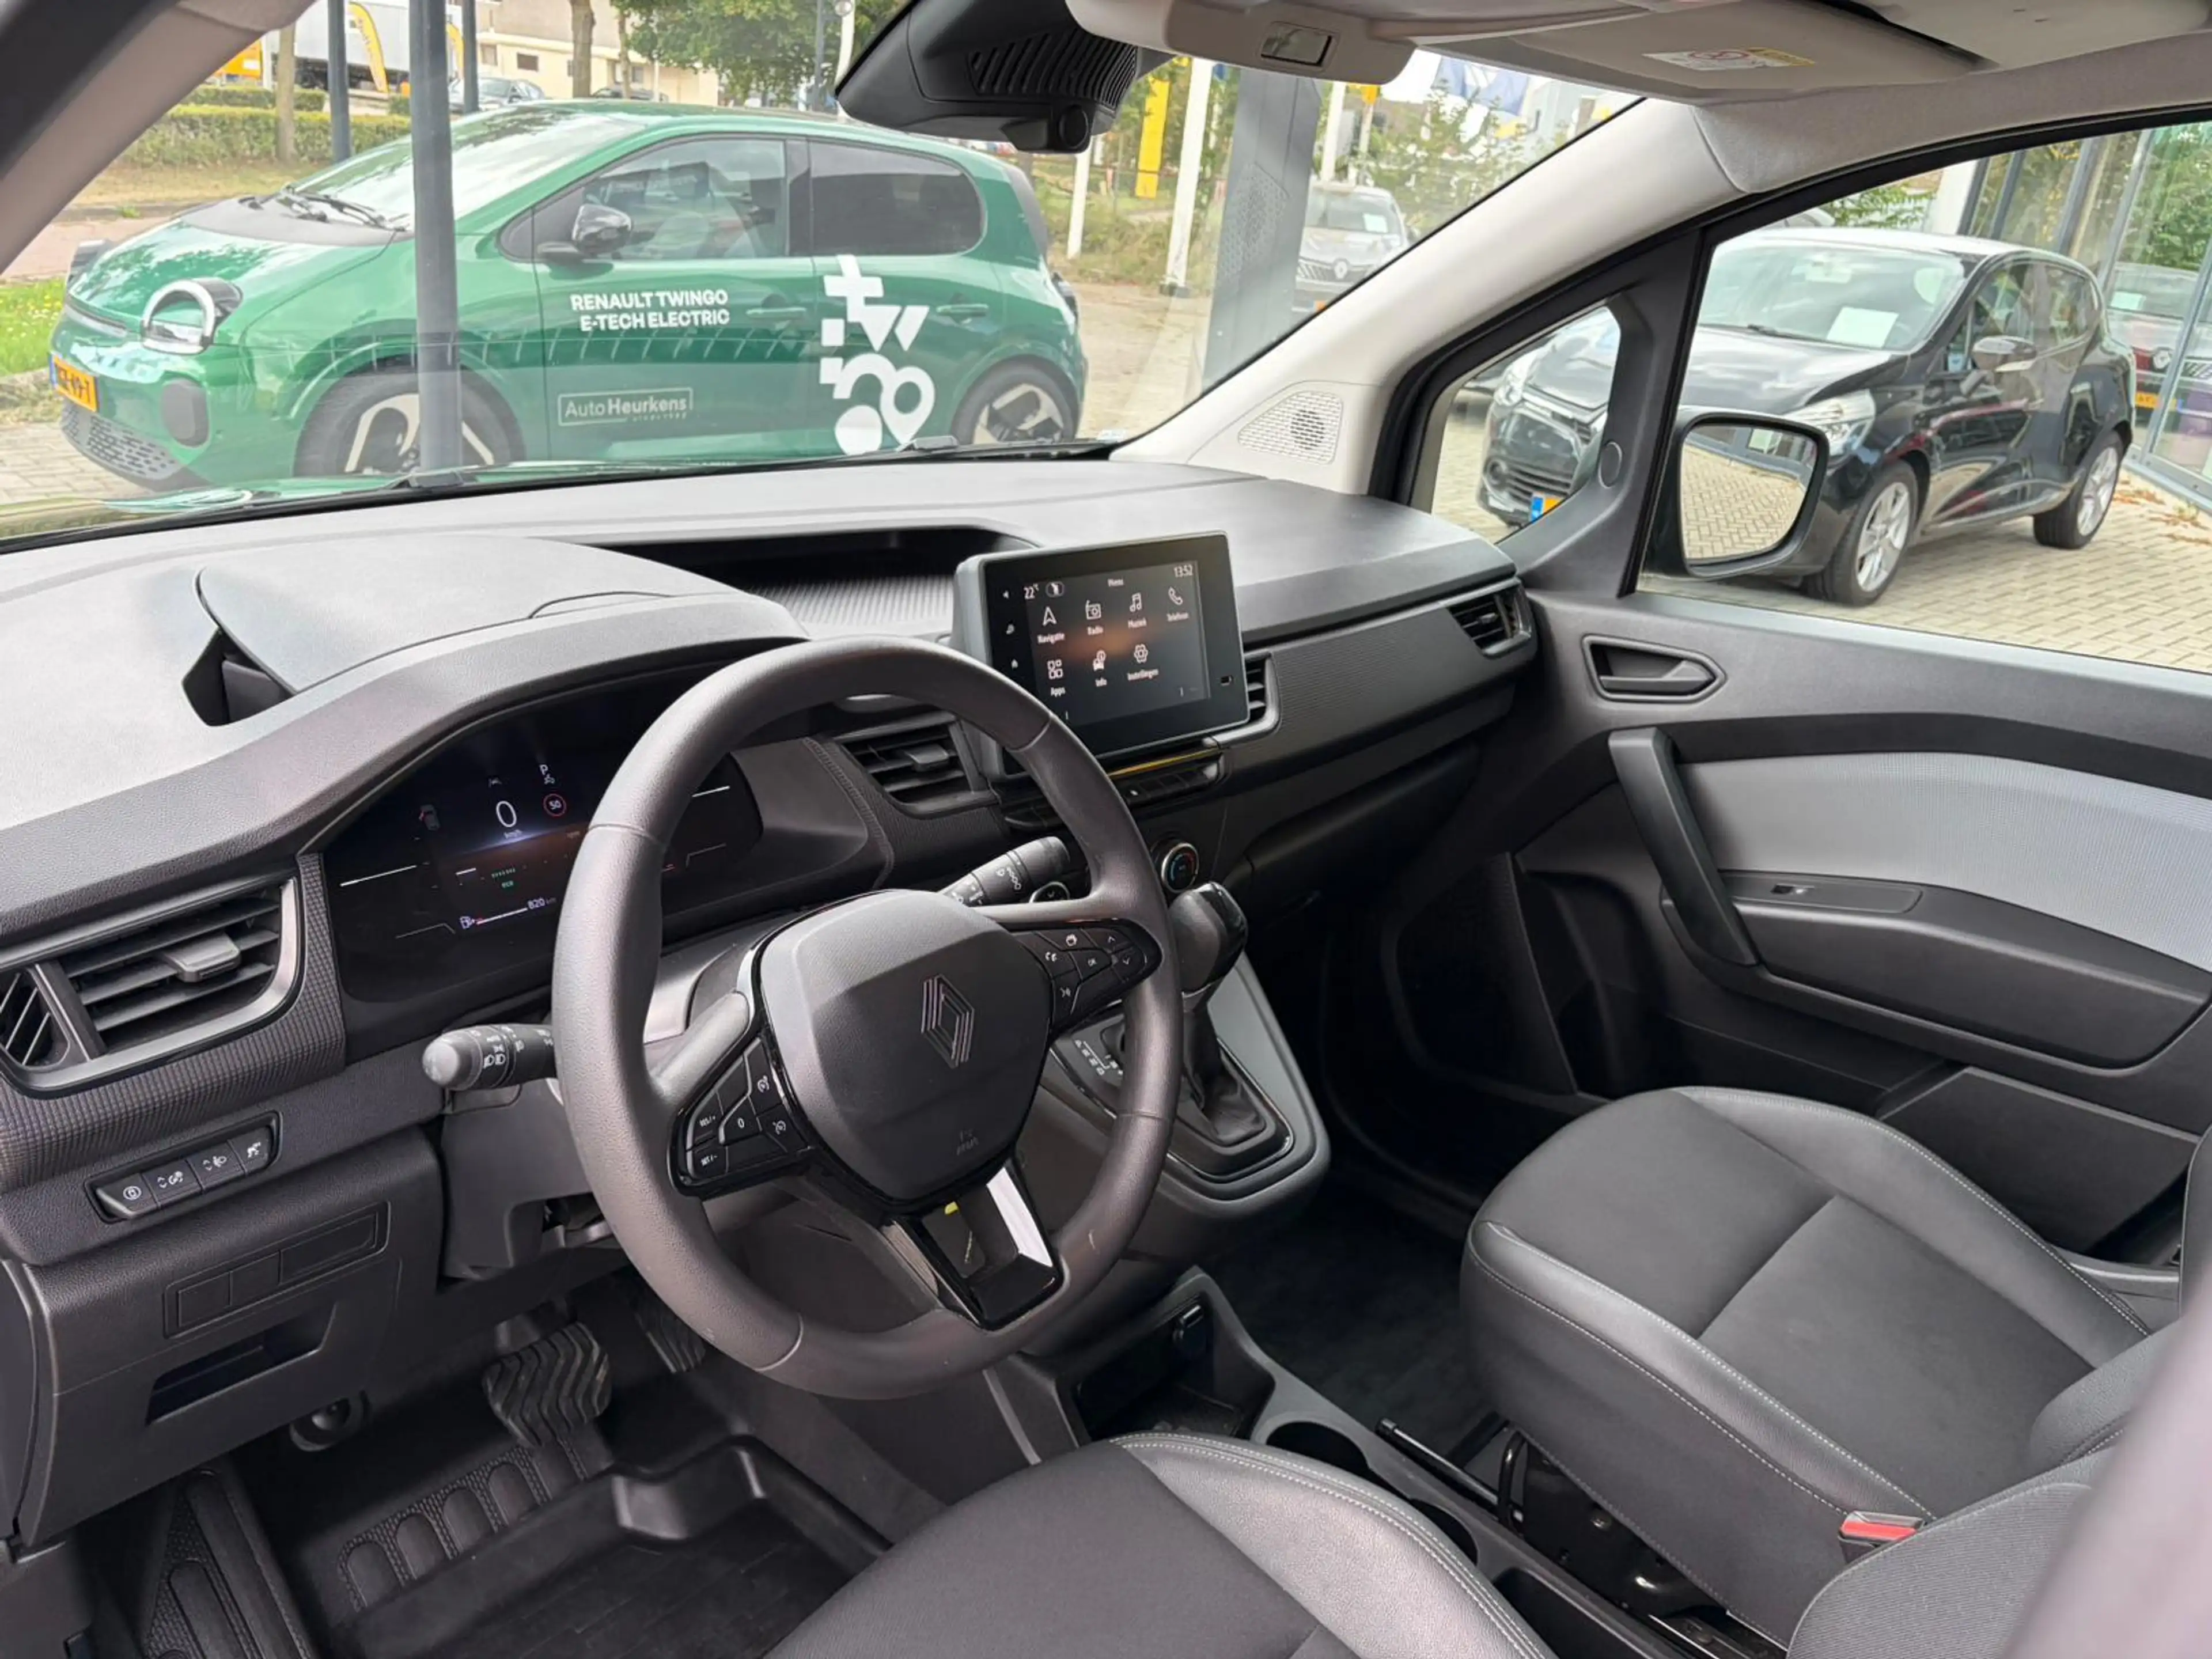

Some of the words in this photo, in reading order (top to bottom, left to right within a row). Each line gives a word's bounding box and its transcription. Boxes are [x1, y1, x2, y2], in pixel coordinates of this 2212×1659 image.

[570, 291, 653, 311] RENAULT
[654, 289, 728, 308] TWINGO
[579, 312, 646, 332] E-TECH
[647, 309, 730, 328] ELECTRIC
[565, 400, 605, 418] Auto
[607, 396, 687, 416] Heurkens
[1050, 687, 1066, 697] Apps
[496, 800, 517, 827] 0
[549, 800, 562, 809] 50
[527, 897, 546, 910] 820
